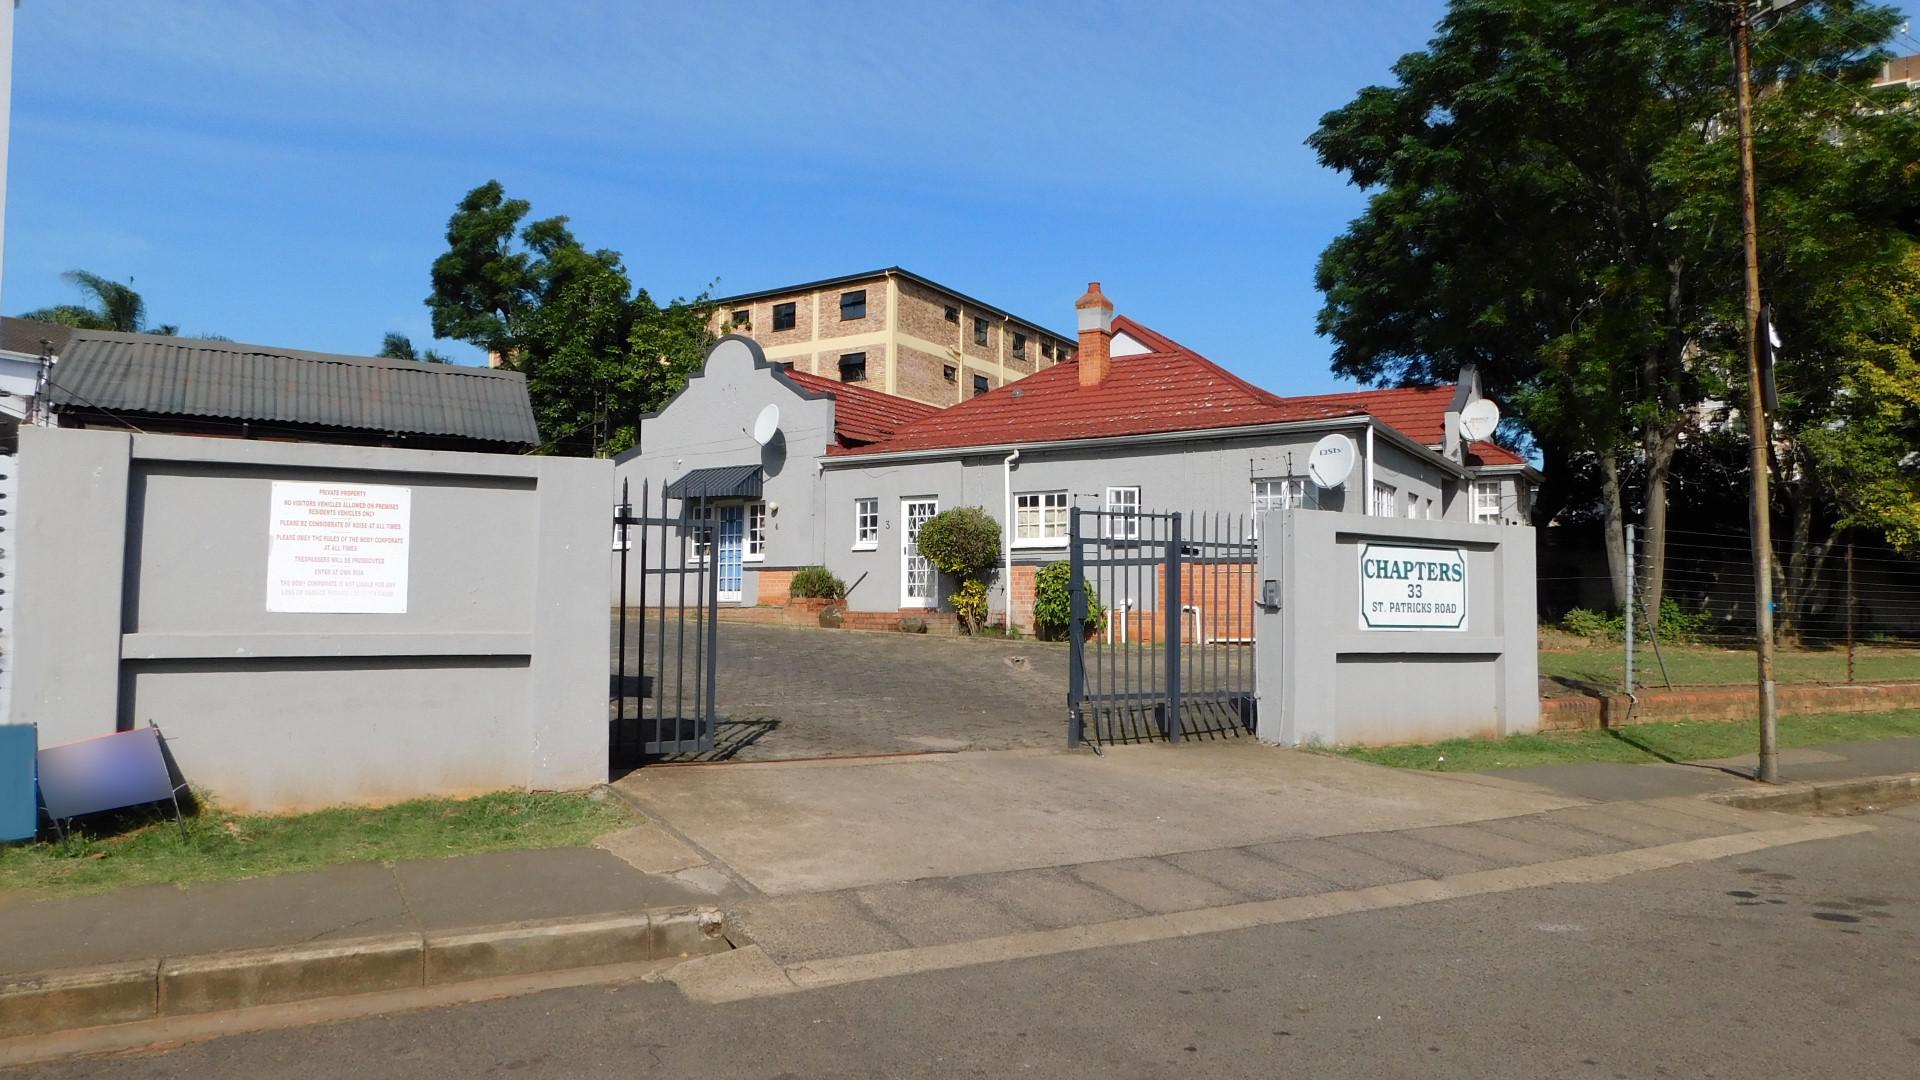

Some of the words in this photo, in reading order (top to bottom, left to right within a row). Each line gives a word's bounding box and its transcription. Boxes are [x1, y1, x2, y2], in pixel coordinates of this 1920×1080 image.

[1363, 559, 1463, 582] CHAPTERS
[1407, 583, 1422, 599] 33
[1372, 601, 1386, 613] ST.
[1389, 602, 1432, 613] PATRICKS
[1434, 603, 1457, 614] ROAD
